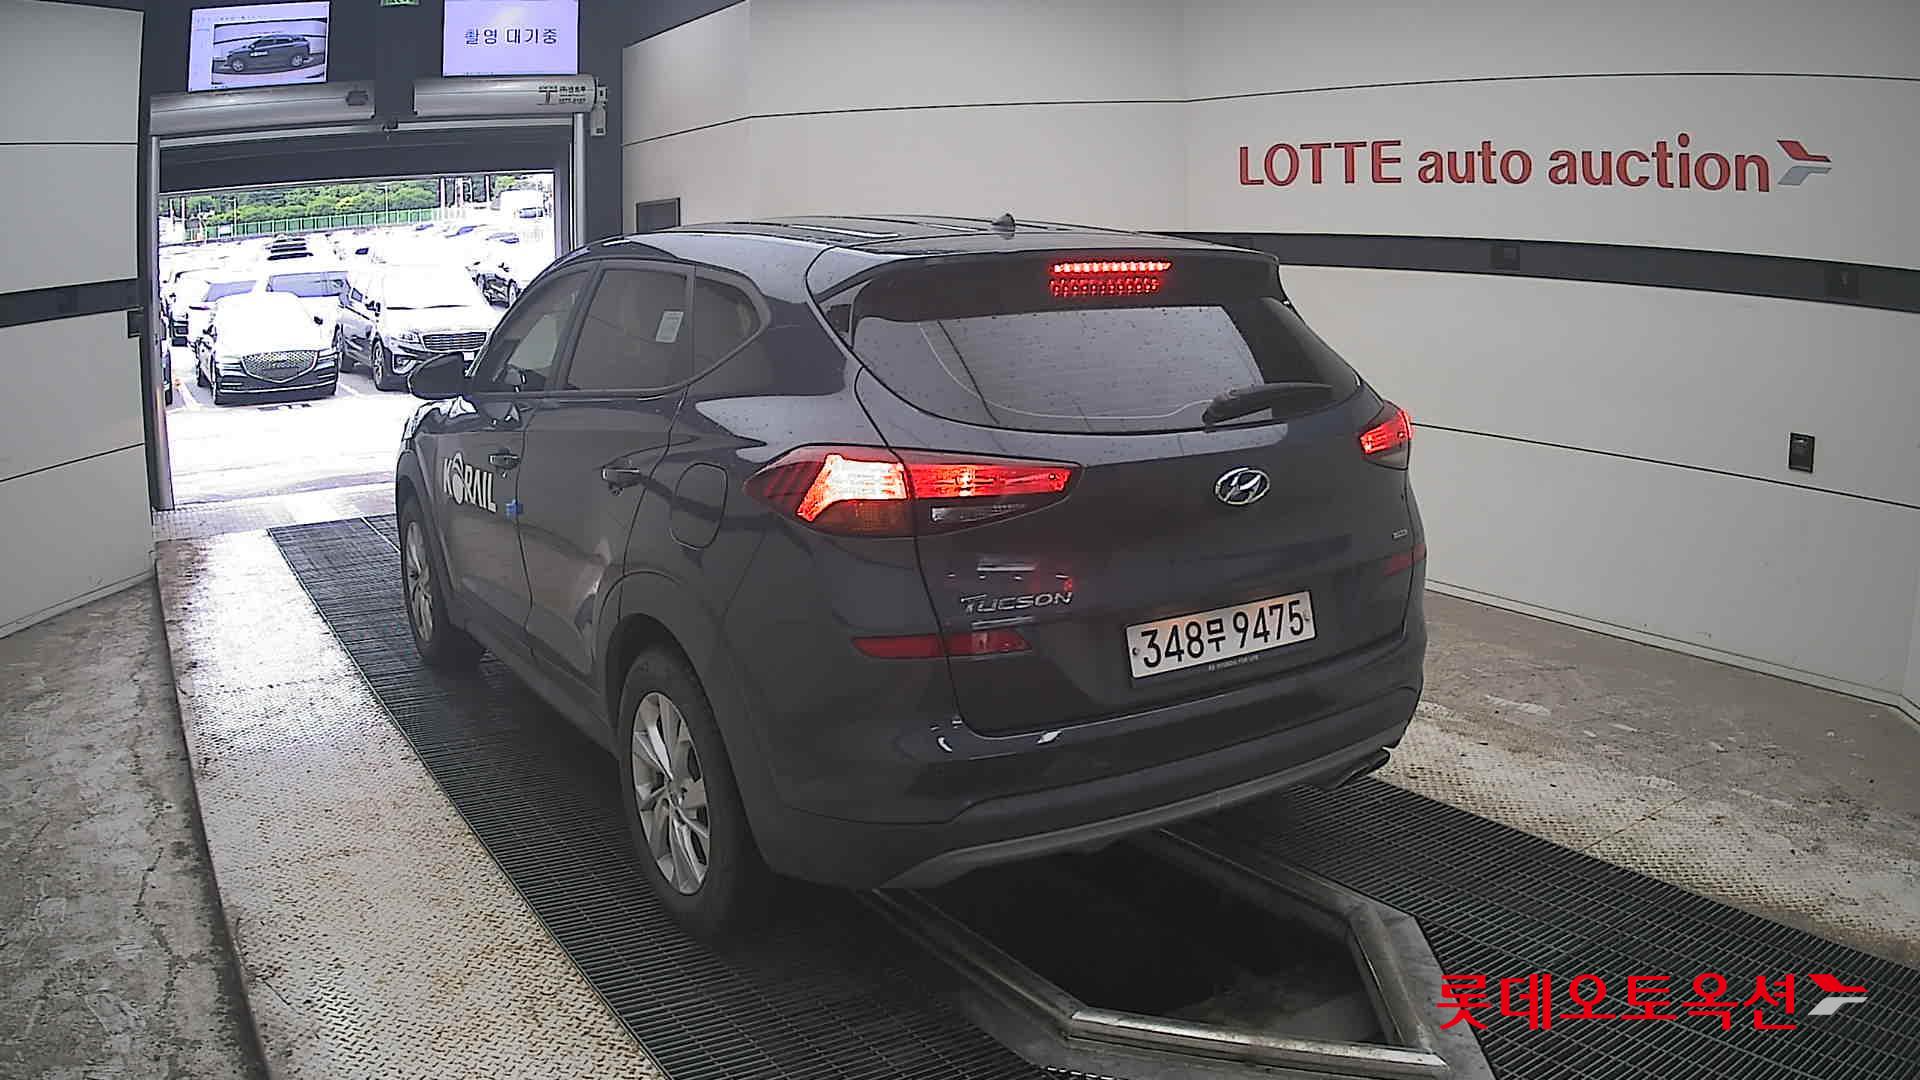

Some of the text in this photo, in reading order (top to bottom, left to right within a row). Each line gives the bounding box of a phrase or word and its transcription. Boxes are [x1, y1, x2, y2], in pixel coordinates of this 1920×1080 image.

[506, 28, 558, 45] 대기중
[1239, 132, 1771, 193] LOTTE auto auction
[443, 451, 497, 513] KORAIL
[960, 591, 1073, 616] TUCSON
[1140, 599, 1305, 668] 348무 9475
